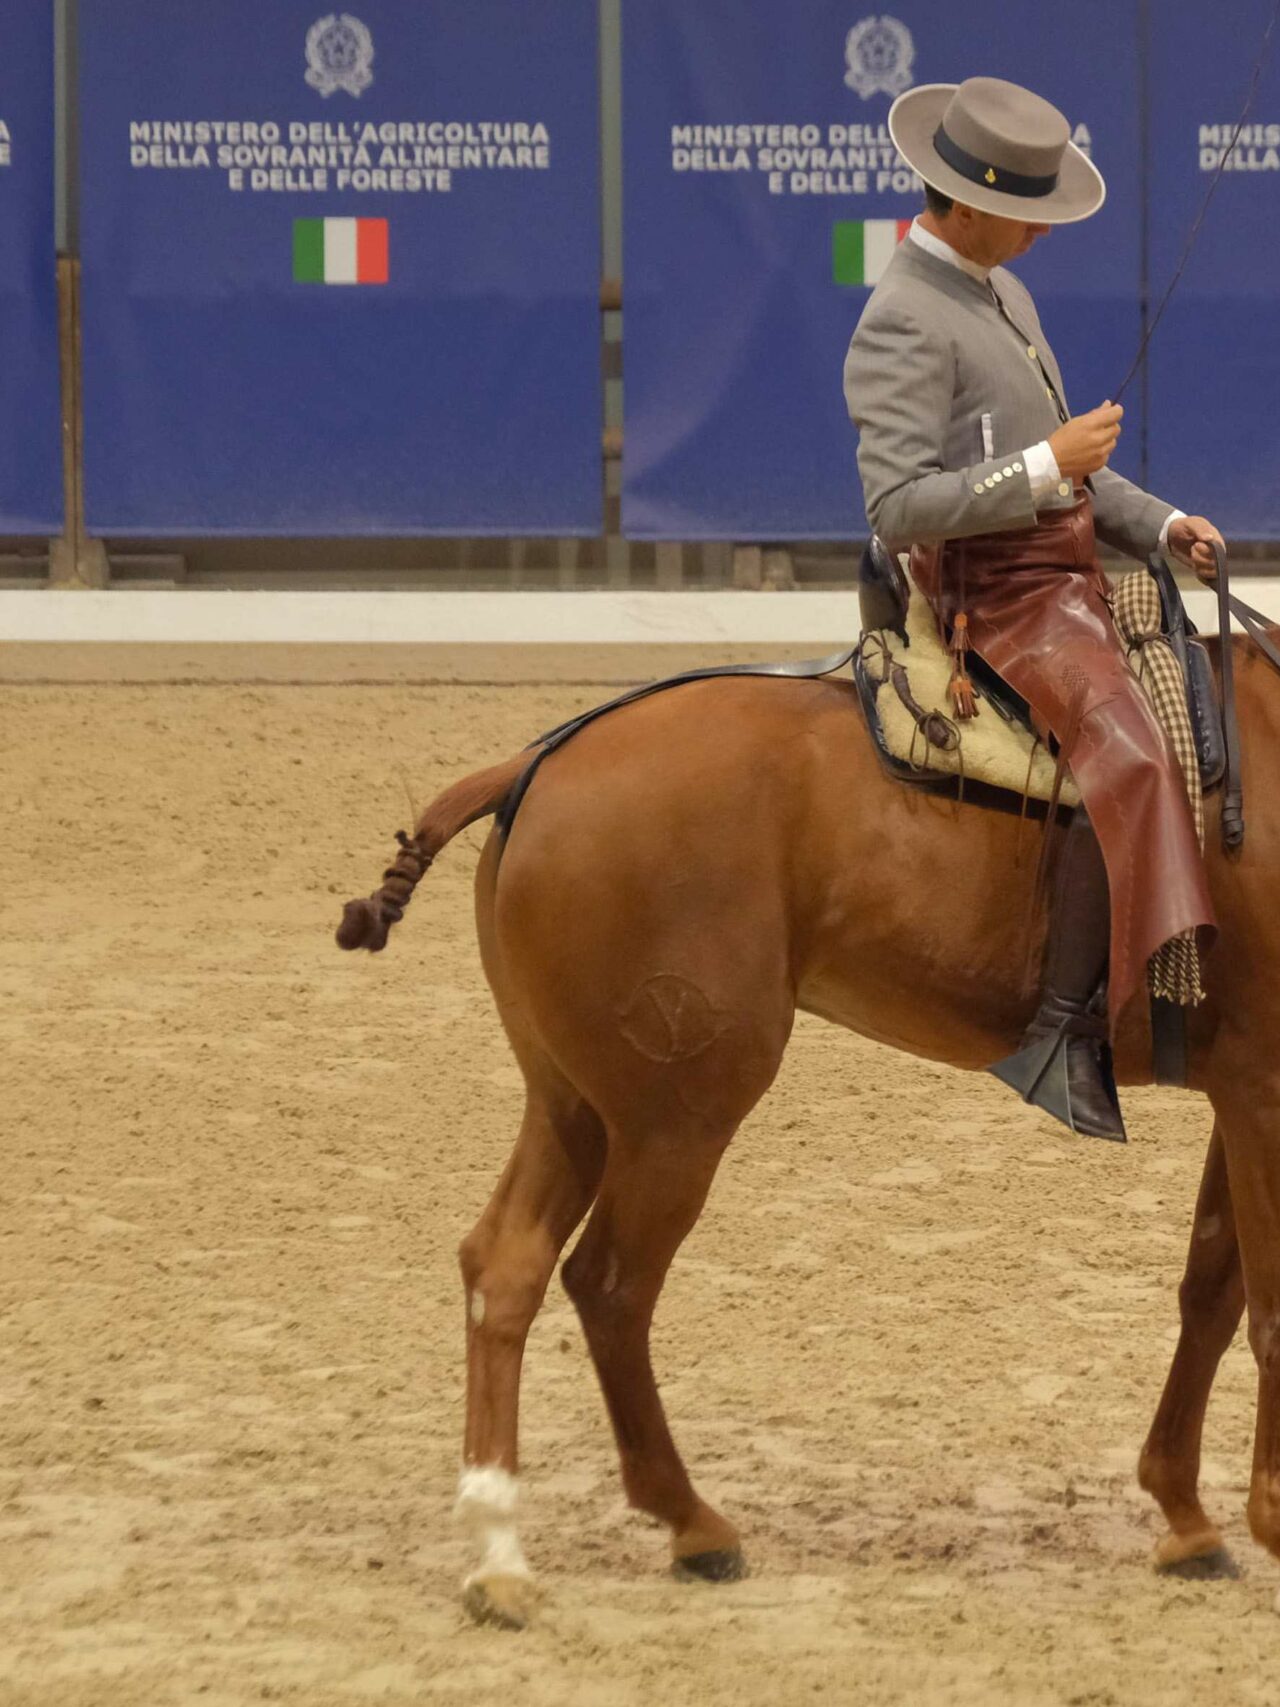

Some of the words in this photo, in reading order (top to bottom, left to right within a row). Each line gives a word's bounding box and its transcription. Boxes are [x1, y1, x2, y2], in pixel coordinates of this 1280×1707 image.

[130, 121, 279, 144] MINISTERO
[289, 121, 549, 144] DELL'AGRICOLTURA
[672, 124, 820, 147] MINISTERO
[131, 145, 209, 167] DELLA
[379, 145, 548, 167] ALIMENTARE
[673, 147, 750, 170] DELLA
[1200, 147, 1280, 169] DELLA
[229, 168, 242, 191] E
[251, 168, 327, 191] DELLE
[337, 168, 450, 191] FORESTE
[769, 170, 782, 193] E
[791, 170, 867, 193] DELLE
